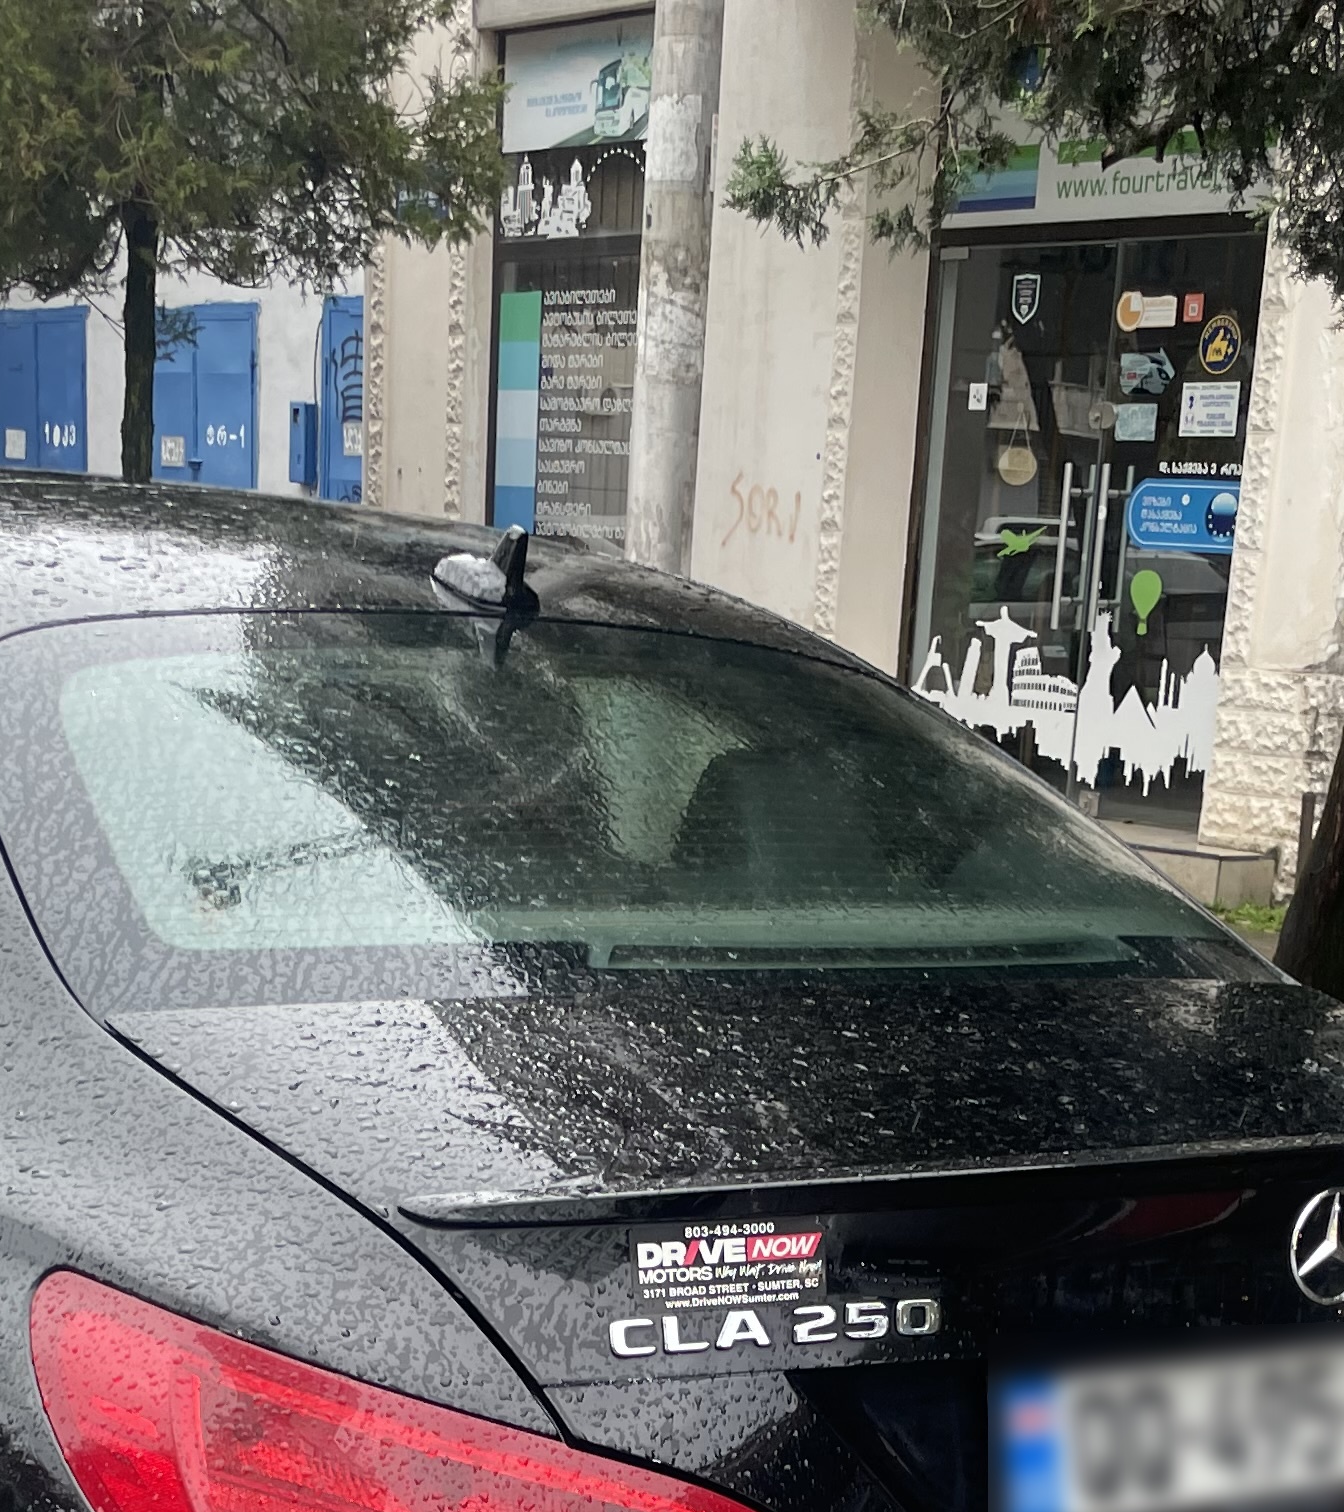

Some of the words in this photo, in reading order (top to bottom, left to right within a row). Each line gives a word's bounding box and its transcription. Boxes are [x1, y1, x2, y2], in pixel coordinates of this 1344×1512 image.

[684, 1221, 775, 1239] 803-494-3000
[637, 1238, 747, 1269] DRIVE
[751, 1235, 816, 1259] NOW
[638, 1265, 714, 1285] MOTORS
[643, 1288, 666, 1299] 3171
[668, 1285, 707, 1297] BROAD
[708, 1282, 750, 1296] STREET
[757, 1279, 804, 1292] SUMTER,
[804, 1277, 819, 1289] SC
[664, 1291, 800, 1310] www.DriveNOWSumter.com
[609, 1309, 772, 1358] CLA
[792, 1298, 942, 1344] 250
